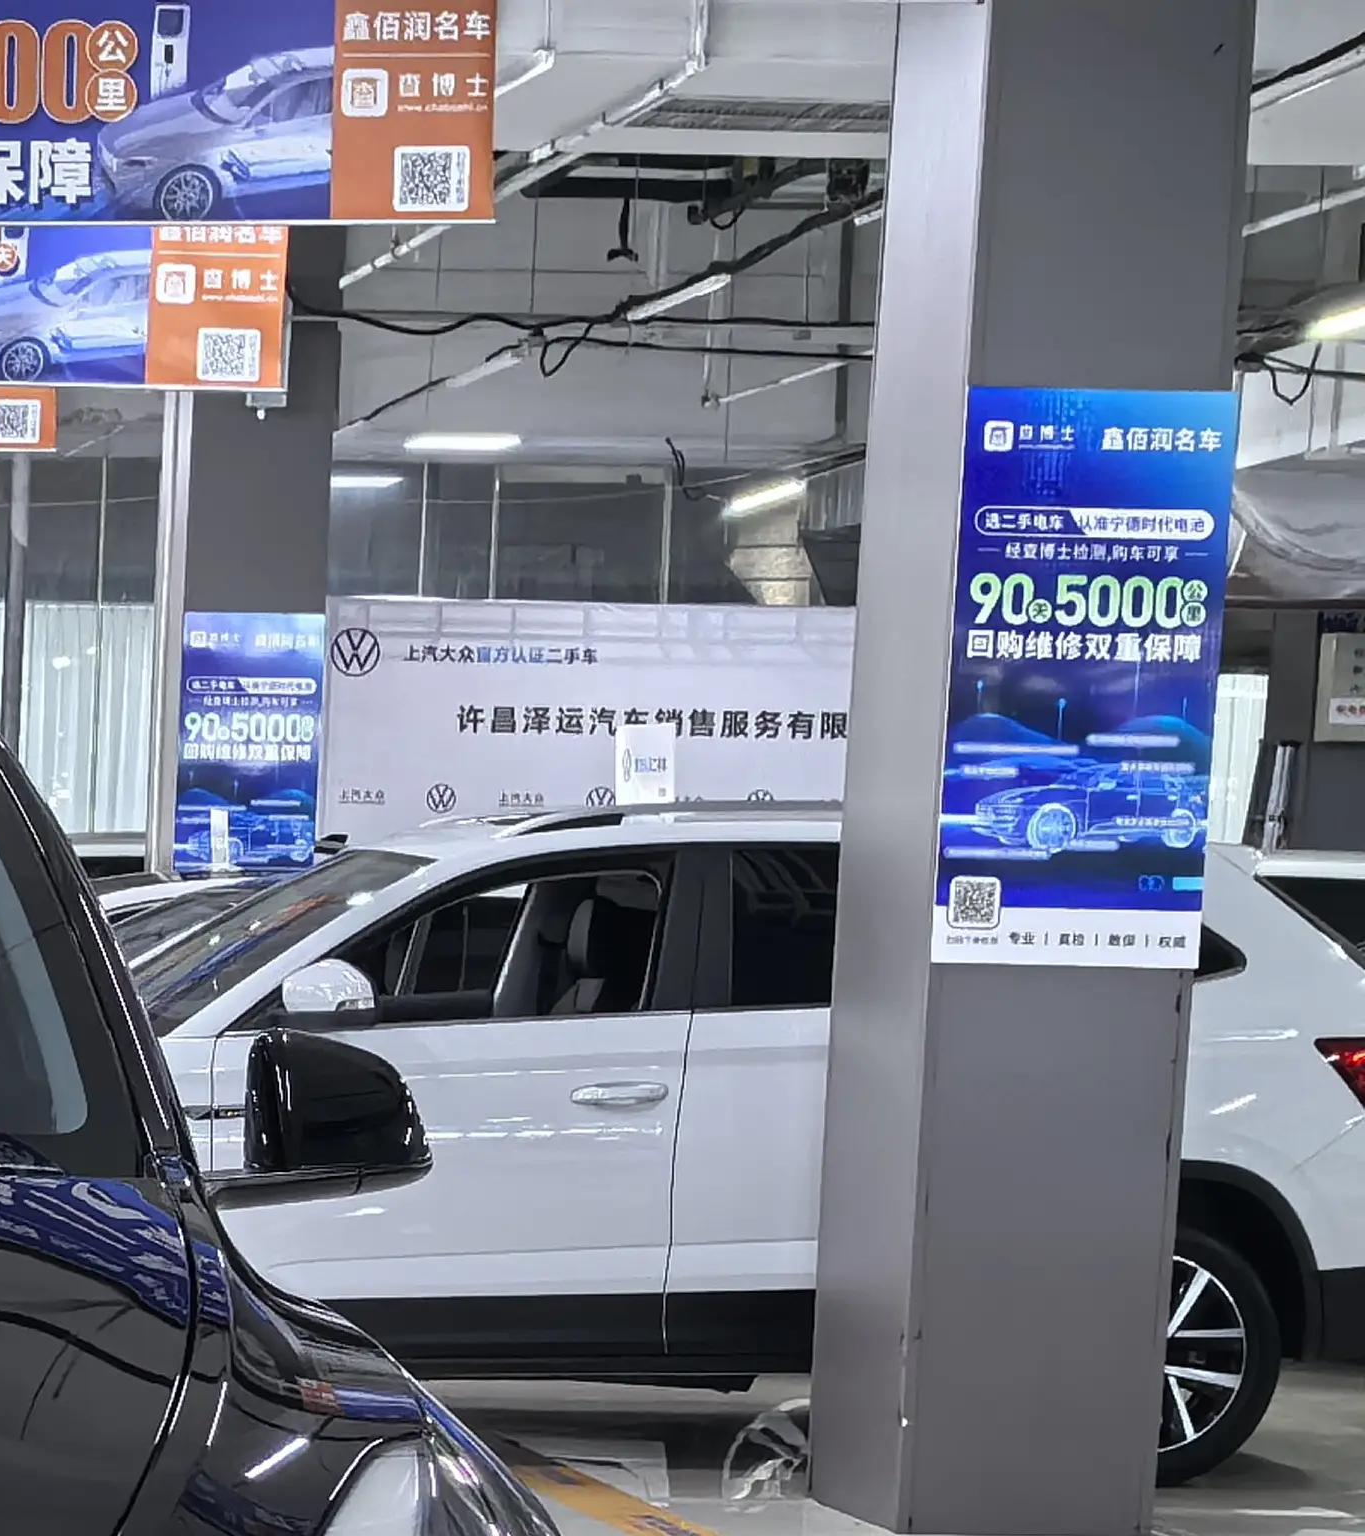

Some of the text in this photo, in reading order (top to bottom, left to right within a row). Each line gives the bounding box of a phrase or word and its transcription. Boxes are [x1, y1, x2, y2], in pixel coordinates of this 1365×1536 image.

[342, 10, 491, 42] 鑫佰润名车
[398, 72, 489, 98] 查博士
[1101, 427, 1223, 453] 鑫佰润名车
[967, 630, 1202, 663] 回购维修双重保障
